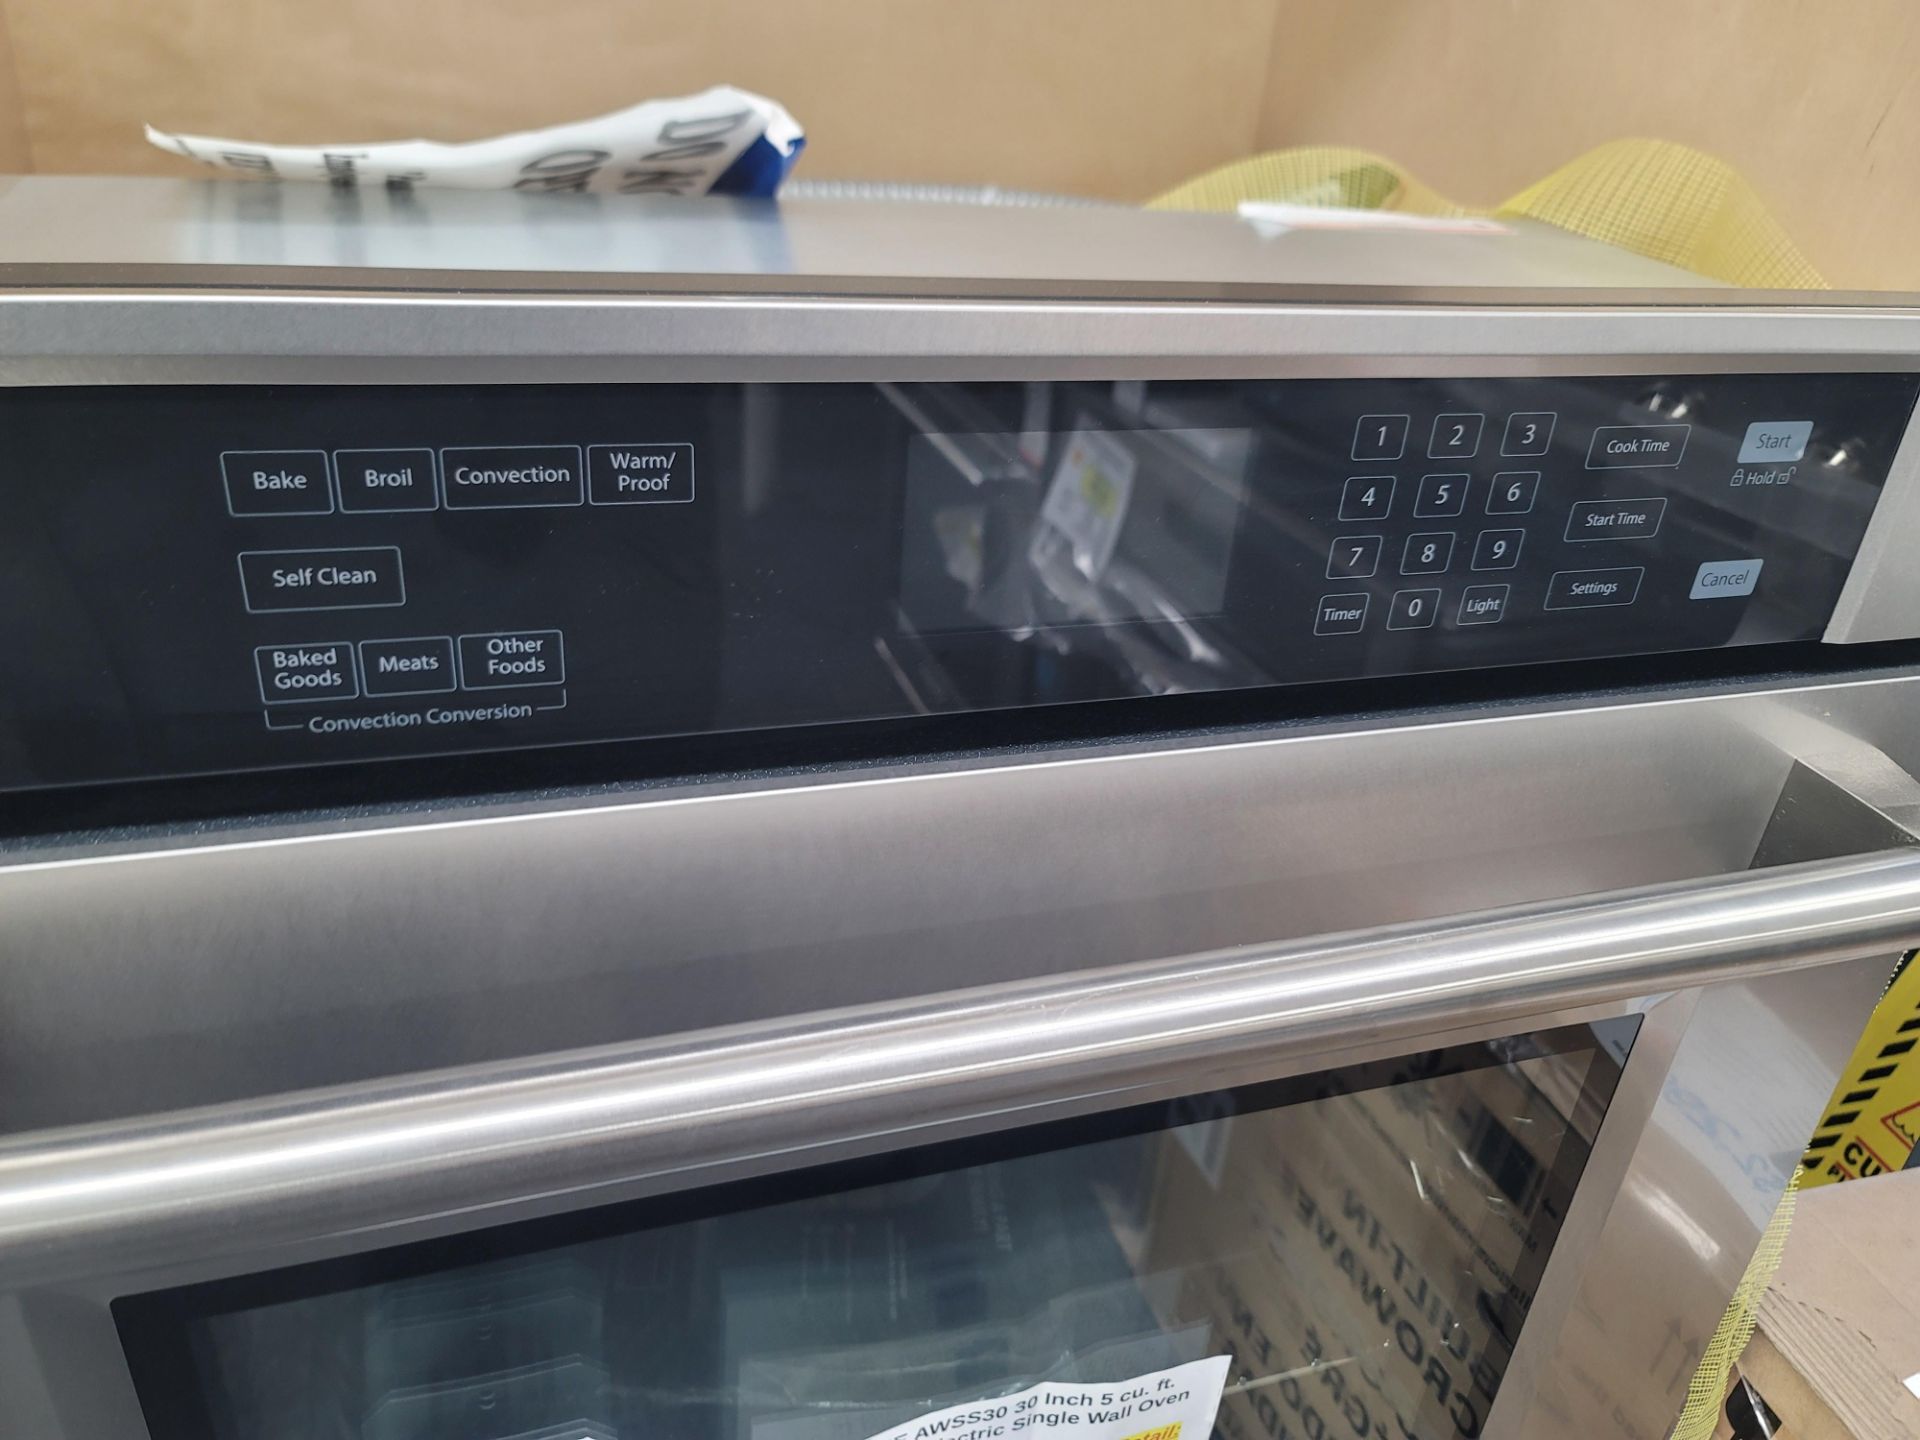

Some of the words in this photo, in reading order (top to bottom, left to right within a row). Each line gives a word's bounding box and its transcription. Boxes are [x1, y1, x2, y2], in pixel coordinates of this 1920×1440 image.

[1376, 425, 1387, 447] 1
[1448, 424, 1464, 446] 2
[1521, 423, 1537, 444] 3
[1755, 433, 1792, 449] Start
[1606, 439, 1639, 454] Cook
[1640, 439, 1671, 452] Time
[609, 451, 677, 470] Warm/
[252, 470, 308, 490] Bake
[364, 468, 413, 488] Broil
[455, 465, 570, 485] Convection
[618, 473, 671, 492] Proof
[1745, 468, 1777, 486] Hold
[1360, 487, 1376, 507] 4
[1434, 484, 1451, 505] 5
[1507, 482, 1521, 502] 6
[1585, 513, 1614, 527] Start
[1616, 512, 1647, 525] Time
[1348, 547, 1364, 567] 7
[1421, 543, 1436, 563] 8
[1492, 540, 1506, 560] 9
[272, 567, 313, 588] Self
[317, 567, 377, 586] Clean
[1700, 569, 1751, 589] Cancel
[1569, 581, 1618, 596] Settings
[1323, 607, 1363, 623] Timer
[1408, 598, 1422, 617] 0
[1466, 596, 1502, 616] Light
[486, 635, 545, 655] Other
[271, 647, 338, 668] Baked
[379, 655, 439, 673] Meats
[488, 656, 546, 675] Foods
[274, 668, 343, 690] Goods
[308, 711, 422, 733] Convection
[425, 703, 533, 724] Conversion
[914, 1406, 1008, 1440] AWSS30
[1014, 1395, 1039, 1414] 30
[1044, 1392, 1093, 1407] Inch
[1100, 1393, 1114, 1406] 5
[1119, 1386, 1150, 1403] cu.
[1157, 1378, 1176, 1392] ft.
[1011, 1411, 1080, 1431] Single
[1087, 1406, 1132, 1424] Wall
[1138, 1389, 1191, 1412] Oven
